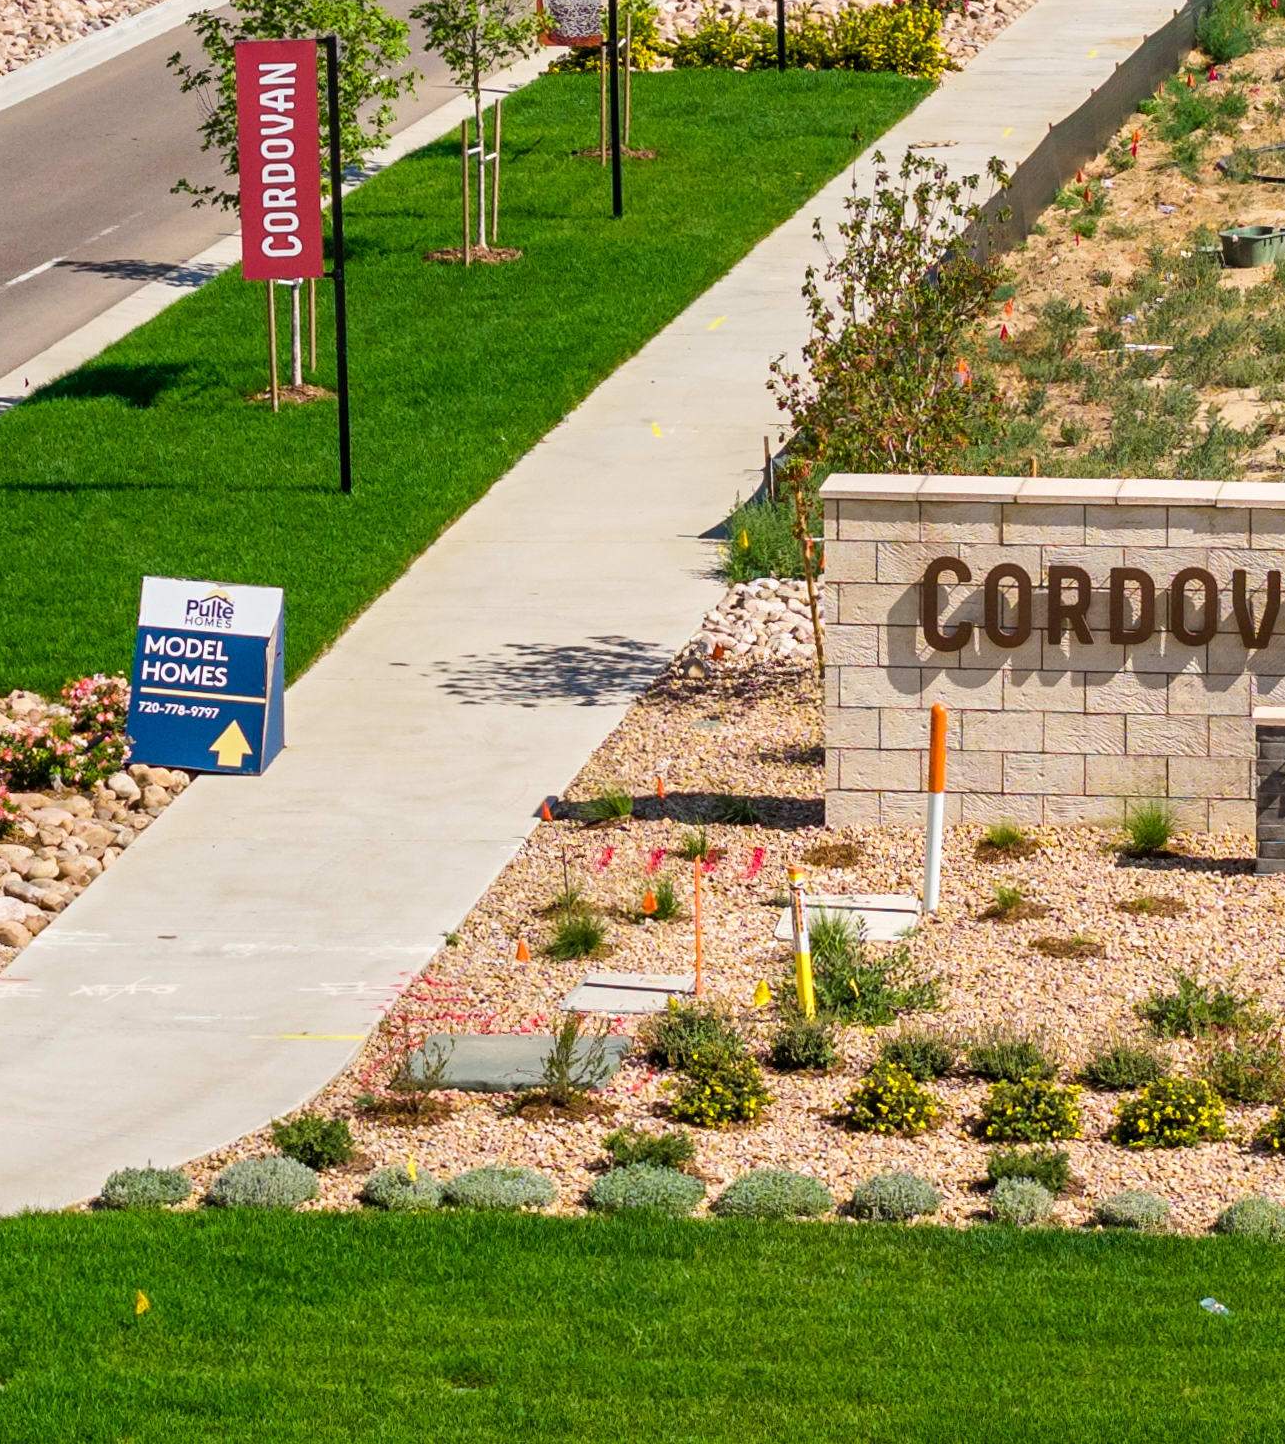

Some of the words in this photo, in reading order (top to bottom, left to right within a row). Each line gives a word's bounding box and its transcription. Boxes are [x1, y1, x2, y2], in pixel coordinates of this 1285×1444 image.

[258, 62, 303, 258] CORDOVAN
[186, 599, 234, 619] Pulte
[185, 616, 232, 629] HOMES
[144, 634, 229, 661] MODEL
[141, 660, 228, 687] HOMES
[138, 701, 220, 719] 720-778-9797
